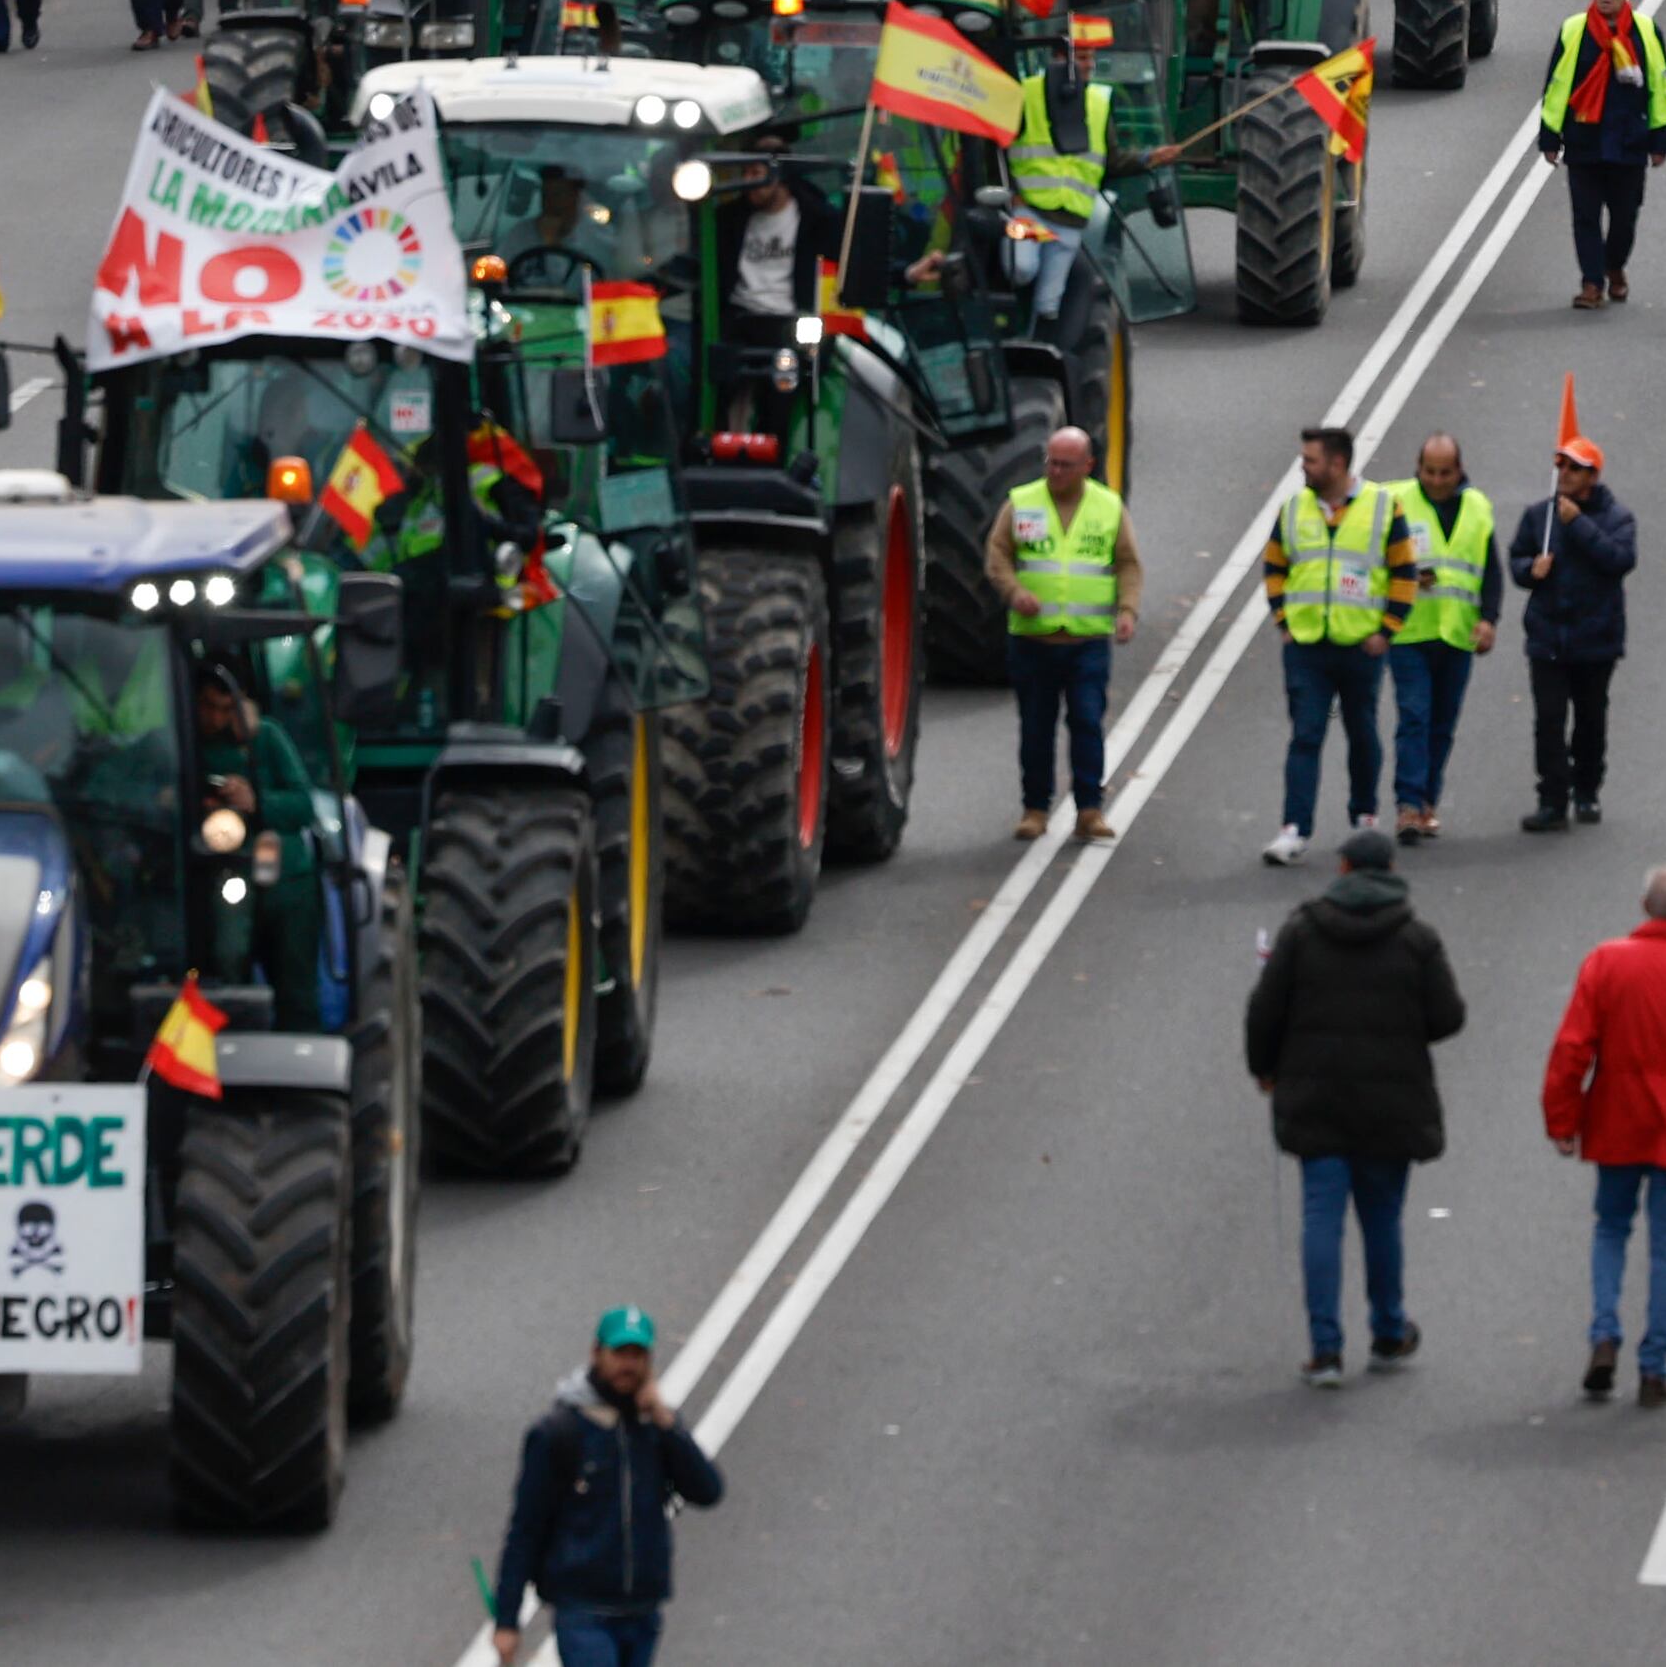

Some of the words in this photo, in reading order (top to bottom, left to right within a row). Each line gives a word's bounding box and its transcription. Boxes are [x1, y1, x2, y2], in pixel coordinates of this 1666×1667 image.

[148, 158, 179, 214] LA
[99, 205, 302, 308] NO
[312, 309, 436, 338] 2030
